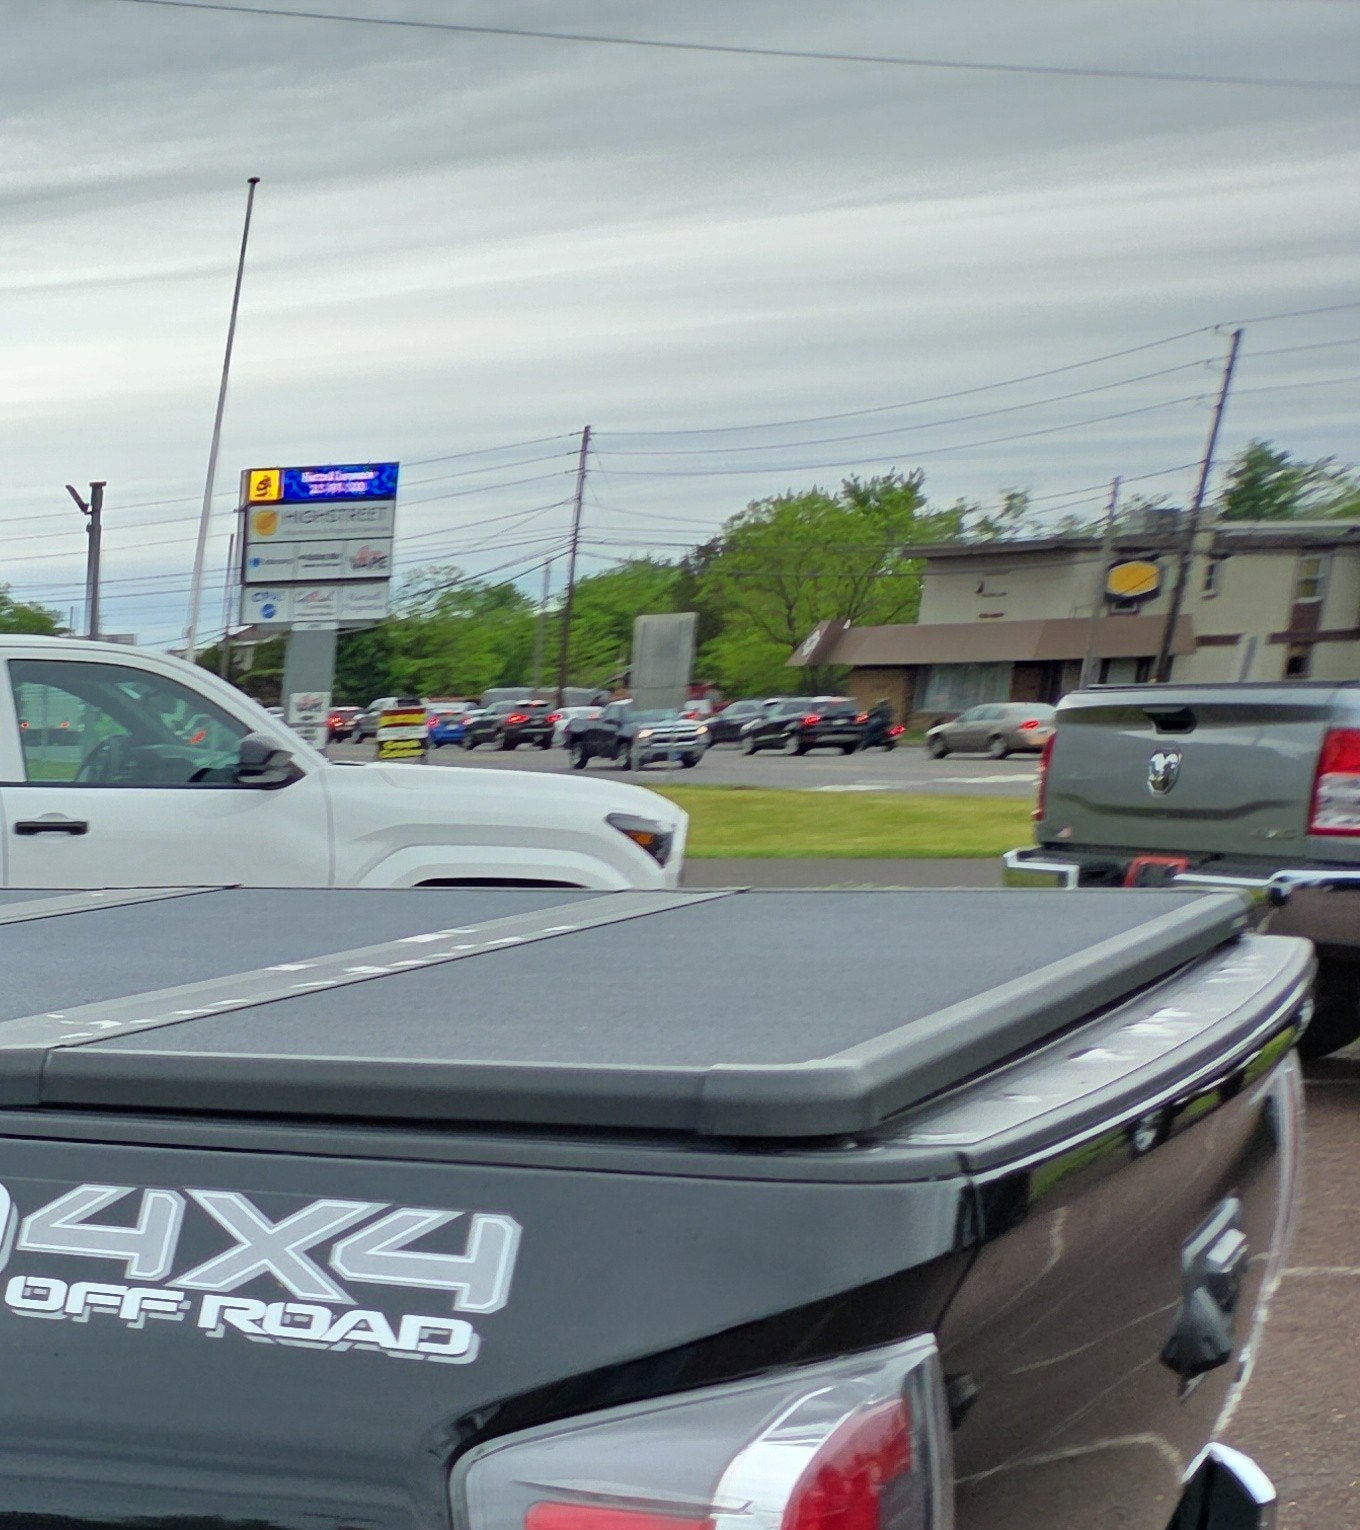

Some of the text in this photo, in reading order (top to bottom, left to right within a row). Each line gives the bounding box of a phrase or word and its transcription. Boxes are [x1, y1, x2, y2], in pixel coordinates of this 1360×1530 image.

[16, 1184, 523, 1314] 4X4
[5, 1276, 480, 1364] OFF ROAD
